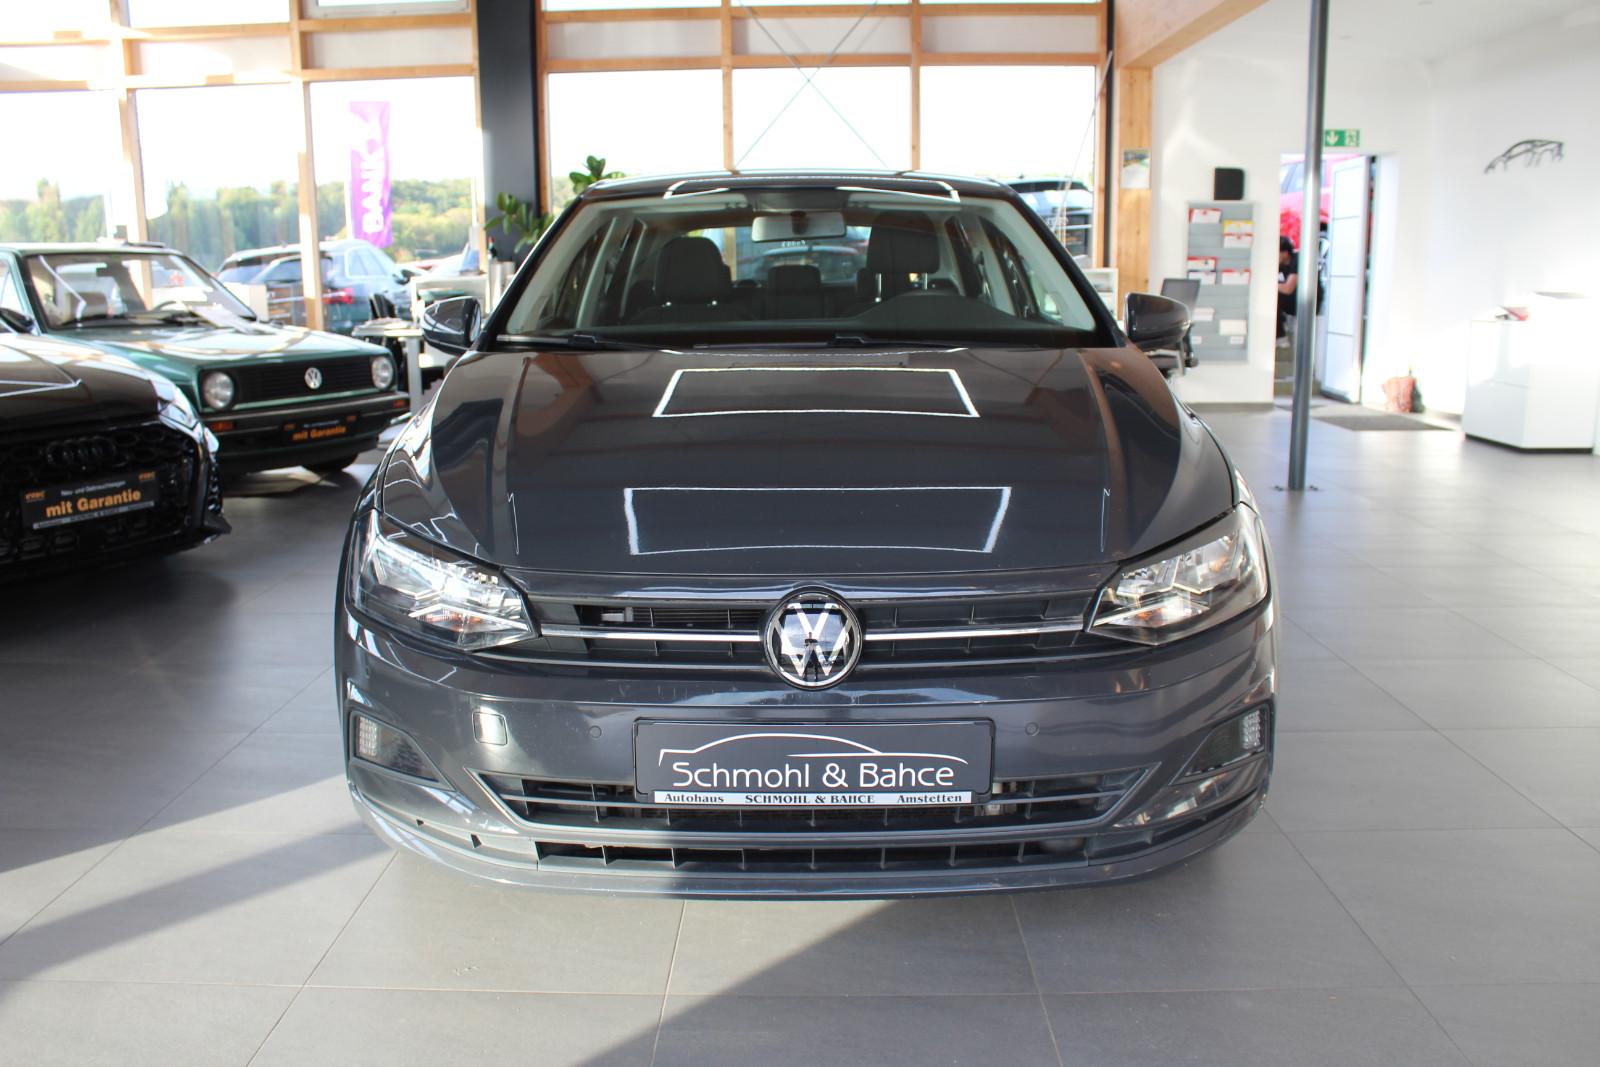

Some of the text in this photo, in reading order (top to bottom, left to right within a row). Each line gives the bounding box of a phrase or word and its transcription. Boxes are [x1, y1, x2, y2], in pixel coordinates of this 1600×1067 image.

[46, 501, 73, 518] mit
[77, 489, 142, 511] Garantie
[672, 762, 954, 788] Schmohl & Bahce
[664, 792, 962, 804] Autohaus SCHMOHL & BAHCE Amstetten
